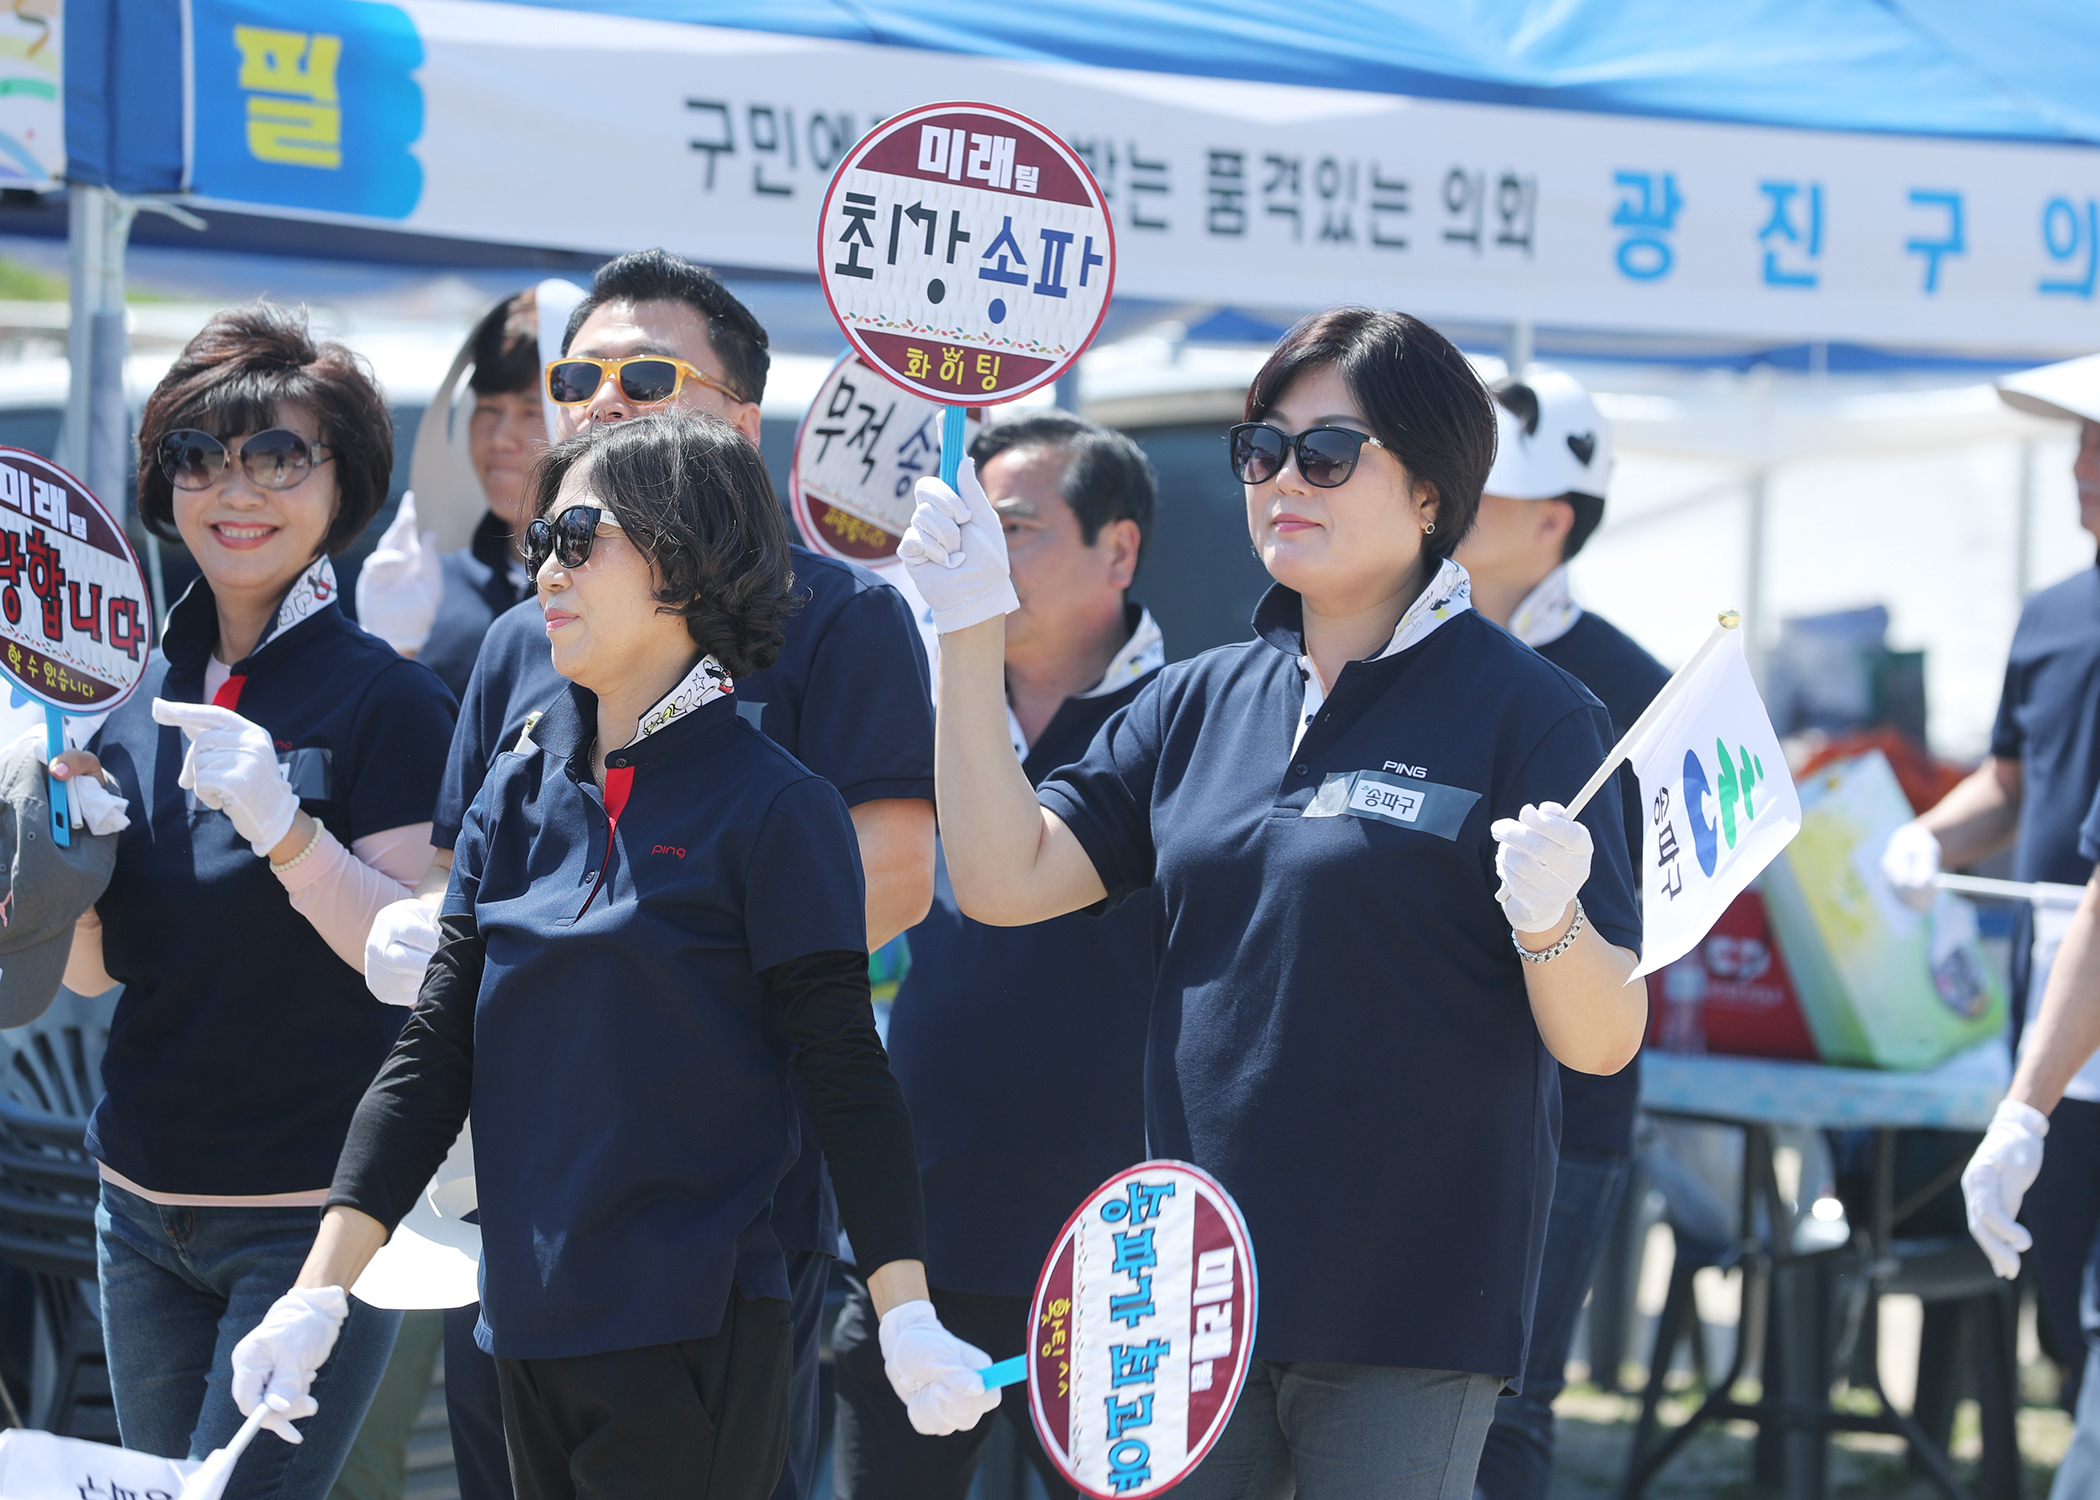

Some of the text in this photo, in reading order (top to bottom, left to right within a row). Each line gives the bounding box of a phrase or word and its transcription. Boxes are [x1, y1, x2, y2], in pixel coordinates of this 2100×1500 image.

[233, 25, 342, 169] 필
[684, 96, 886, 197] 구민에
[1205, 150, 1412, 250] 품격있는
[1443, 165, 1537, 258] 의회
[917, 124, 1040, 195] 미래팀
[834, 191, 1105, 325] 최강 송파
[903, 346, 1001, 392] 화이팅
[814, 374, 943, 499] 무적 송
[0, 461, 88, 541] 미래팀
[8, 643, 95, 698] 할 수 있습니다
[1365, 788, 1416, 815] 송파구
[1382, 760, 1428, 779] PING
[651, 844, 686, 859] ping
[1653, 786, 1682, 902] 송파구
[1100, 1181, 1176, 1493] 송파가 최고야
[1191, 1246, 1235, 1393] 미래팀
